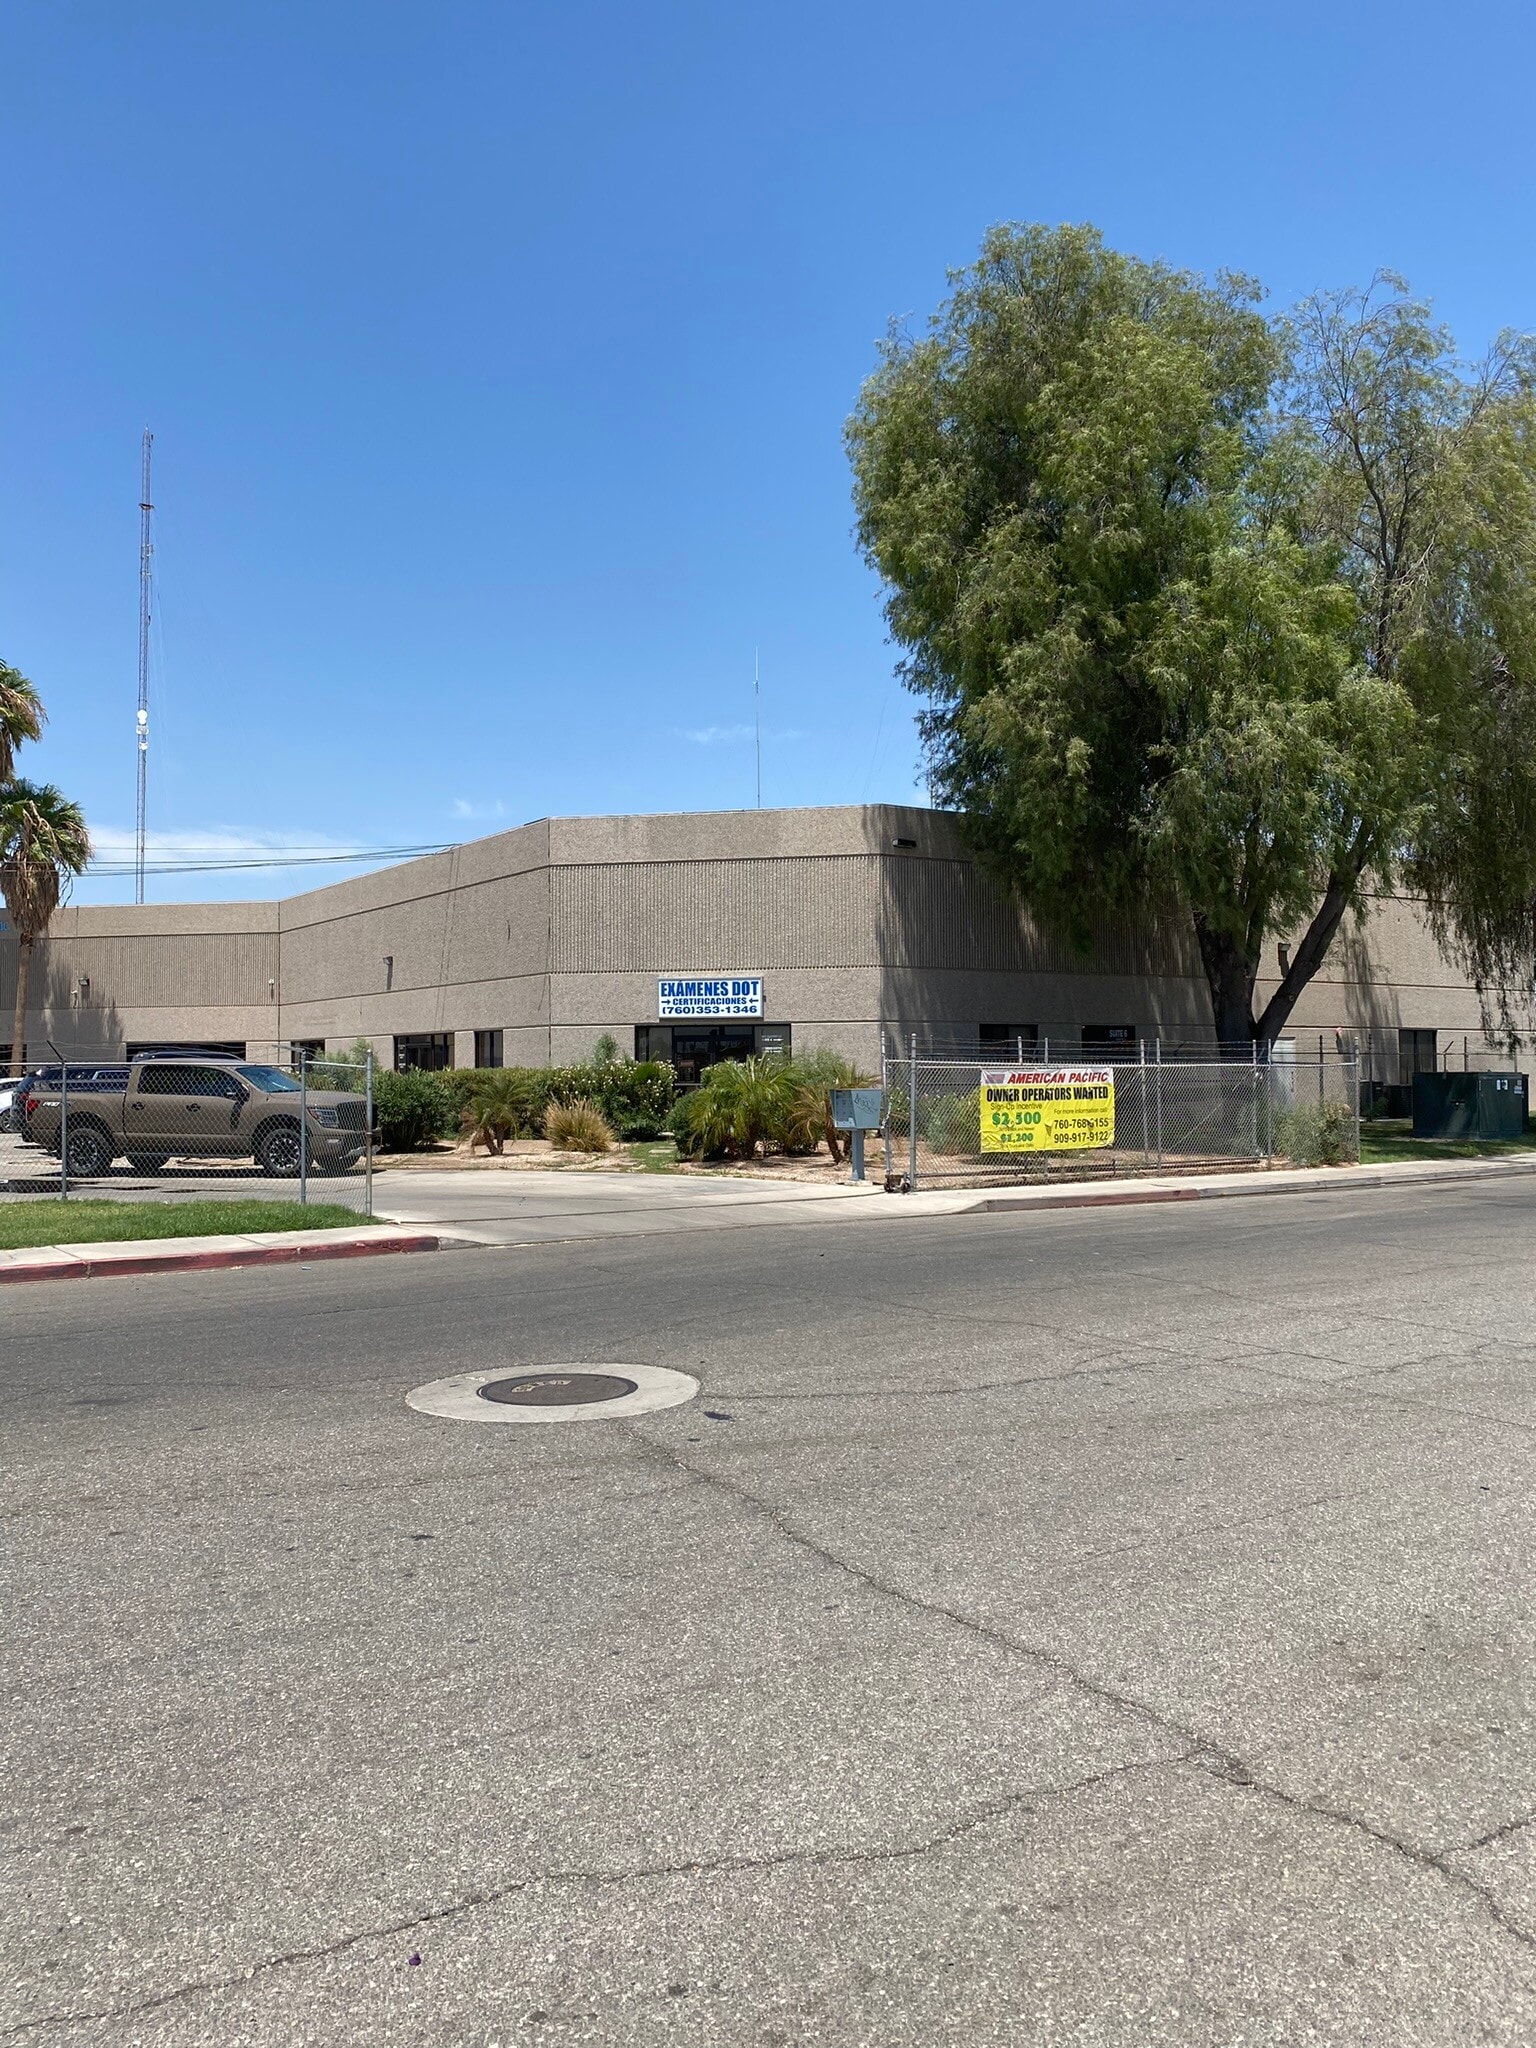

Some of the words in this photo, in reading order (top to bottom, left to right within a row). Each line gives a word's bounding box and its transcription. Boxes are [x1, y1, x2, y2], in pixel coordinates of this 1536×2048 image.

[732, 981, 759, 996] DOT
[663, 1006, 757, 1014] (760)353-1346
[1008, 1073, 1065, 1084] AMERICAN
[1069, 1073, 1108, 1083] PACIFIC
[987, 1088, 1019, 1102] OWNER
[1022, 1087, 1071, 1101] OPERATORS
[1073, 1086, 1109, 1099] WANTED
